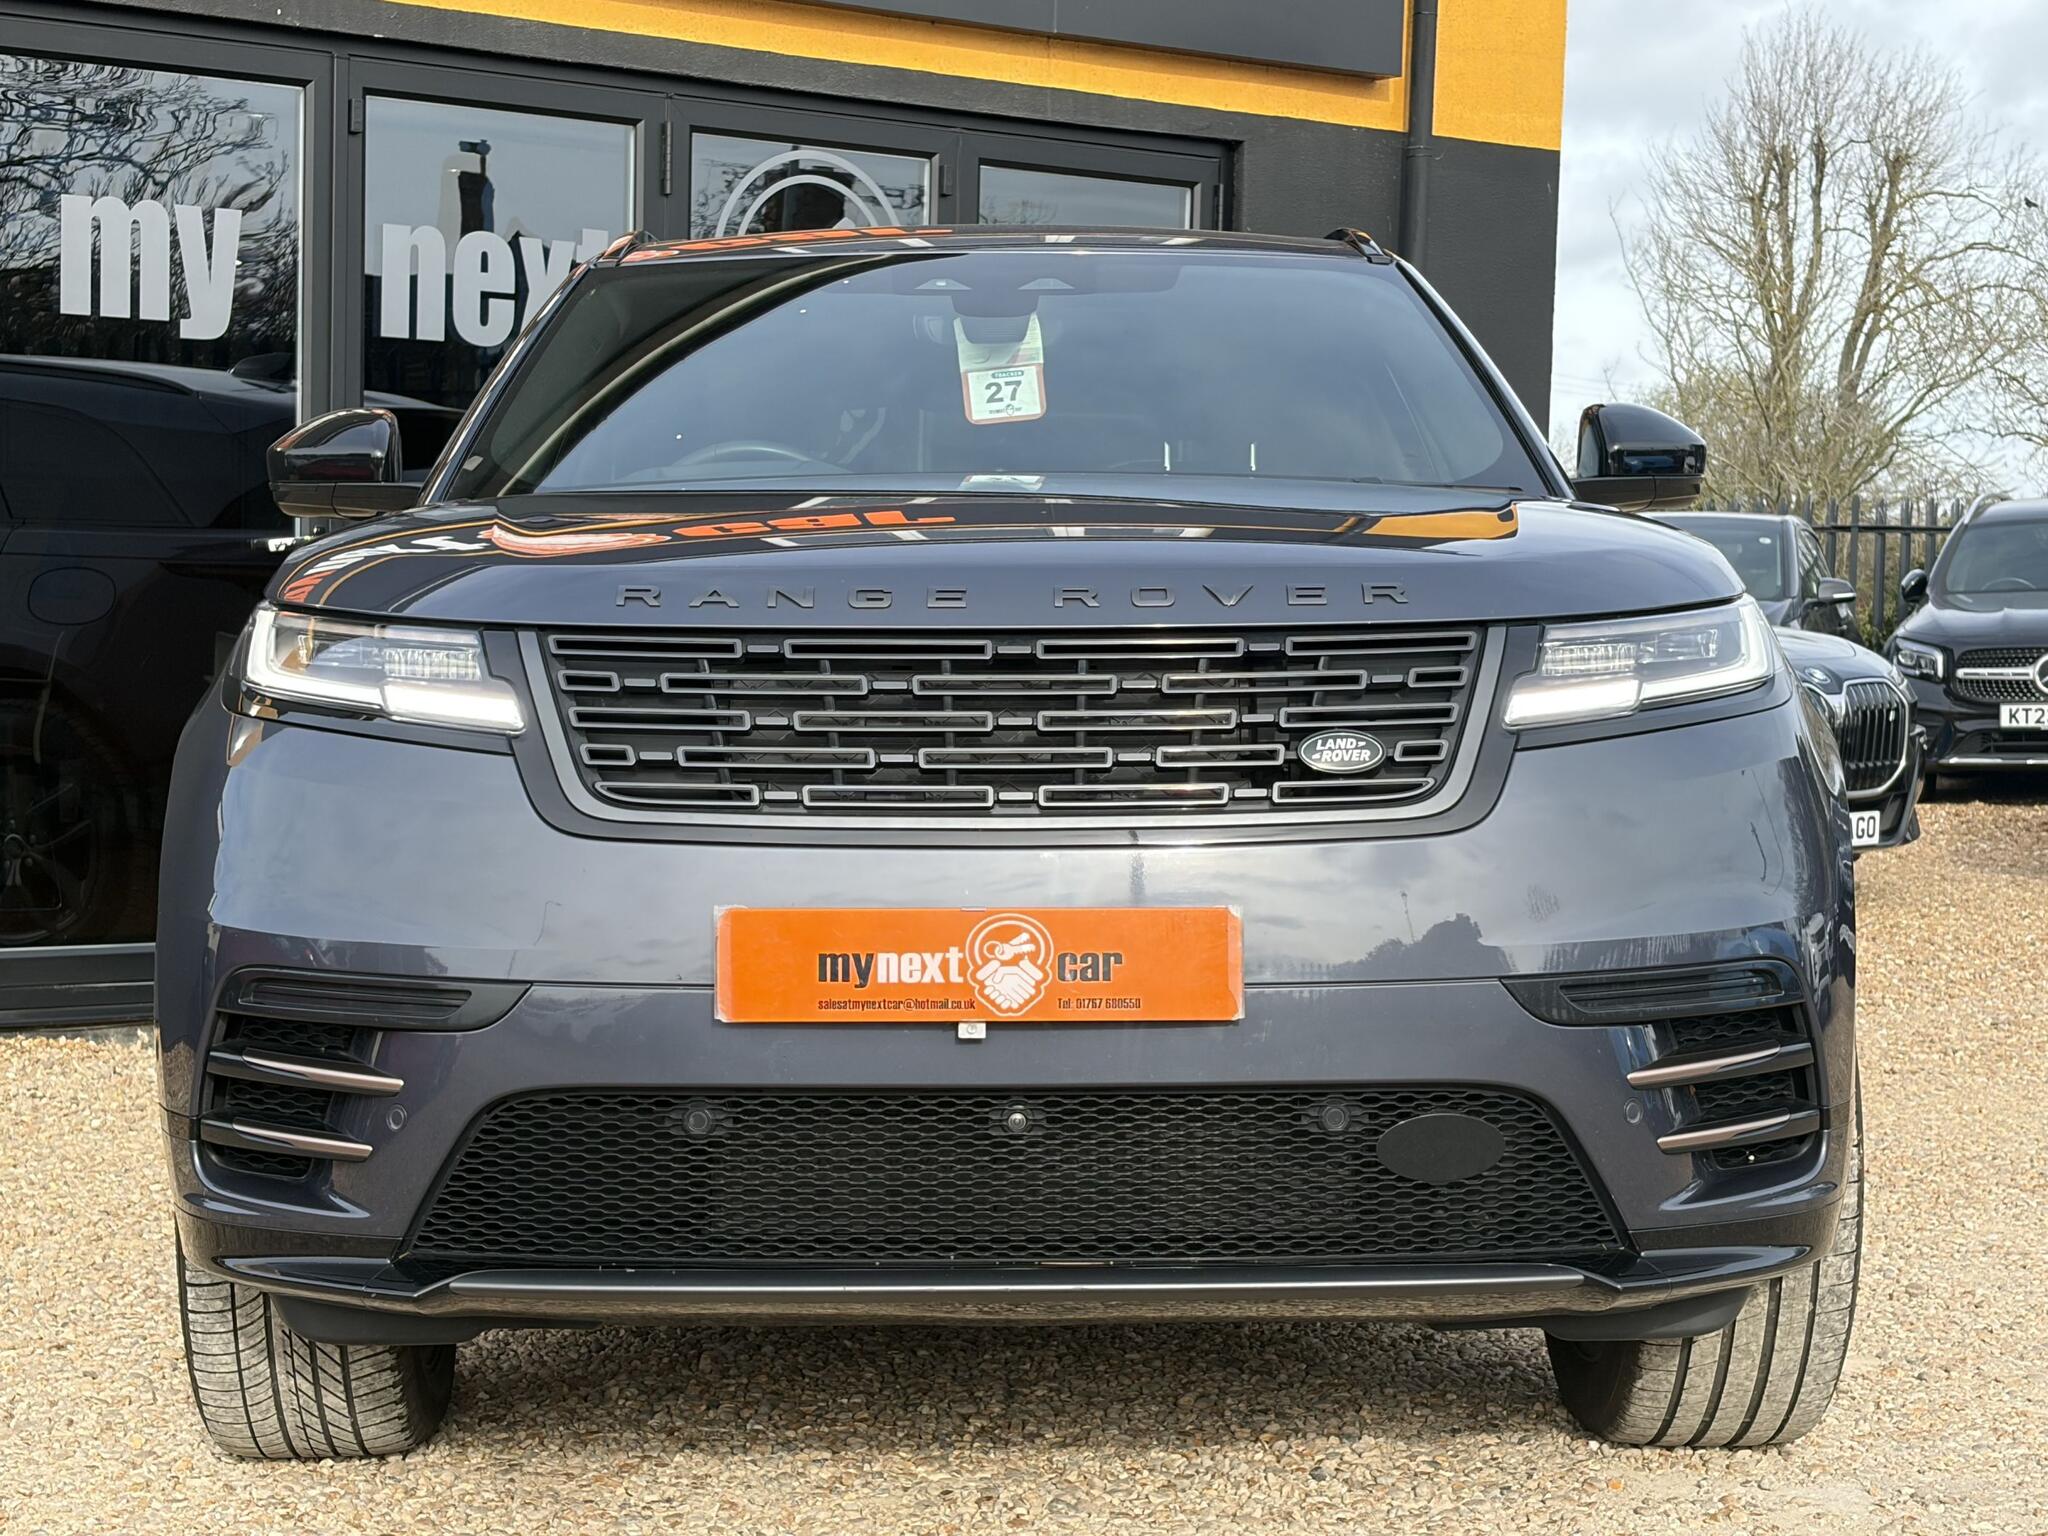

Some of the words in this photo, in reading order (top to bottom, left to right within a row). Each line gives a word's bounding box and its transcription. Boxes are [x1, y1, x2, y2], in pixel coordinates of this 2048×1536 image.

[60, 194, 243, 340] my
[380, 223, 609, 348] nex
[985, 380, 1022, 404] 27
[615, 584, 967, 608] RANGE
[1053, 582, 1409, 608] ROVER
[2009, 707, 2048, 725] KT2
[1316, 738, 1356, 750] LAND
[1321, 749, 1371, 762] ROVER
[1057, 952, 1123, 982] car
[818, 998, 976, 1011] salesatmynextcar@hotmail.co.uk
[1076, 998, 1102, 1009] 01767
[1105, 998, 1141, 1009] 680550
